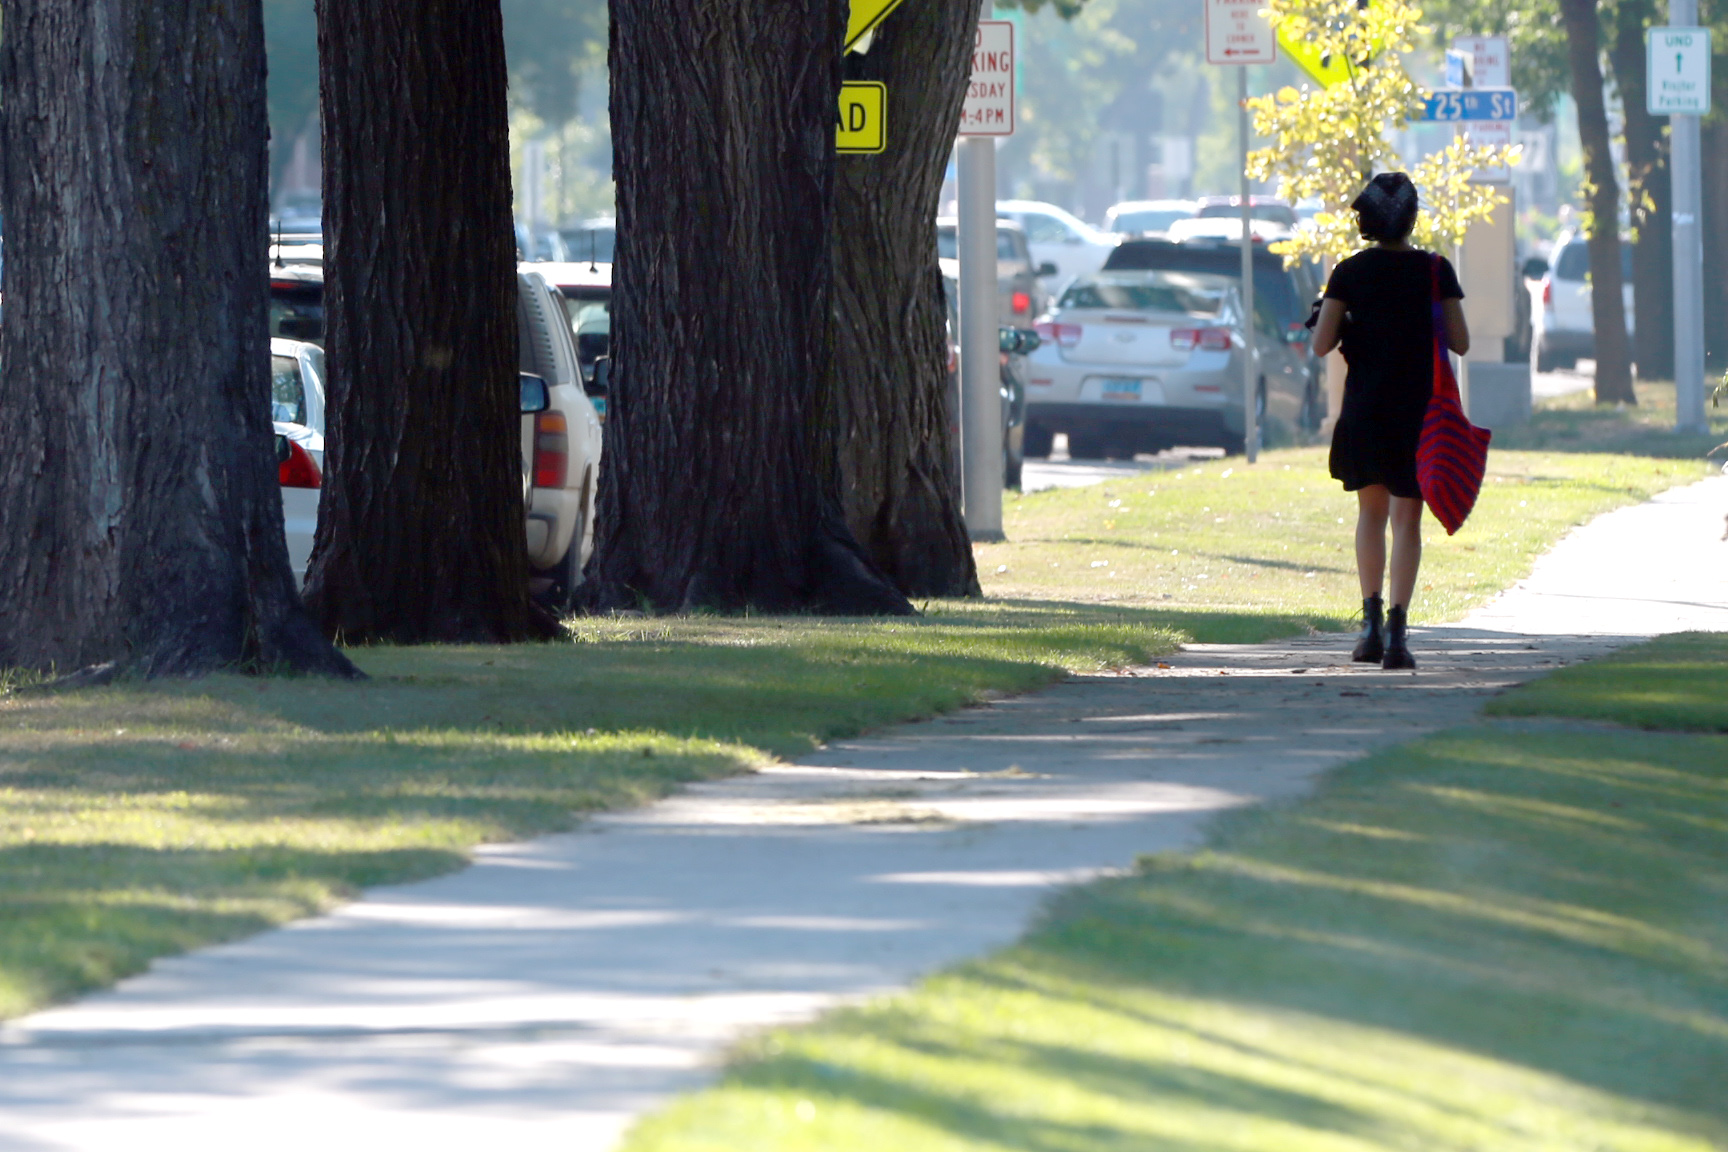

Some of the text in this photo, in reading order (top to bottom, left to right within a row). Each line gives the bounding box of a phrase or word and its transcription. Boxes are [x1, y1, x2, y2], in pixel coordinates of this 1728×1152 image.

[1665, 34, 1694, 48] UND
[971, 51, 1010, 73] KING
[965, 81, 1006, 99] SDAY
[1490, 93, 1512, 119] St
